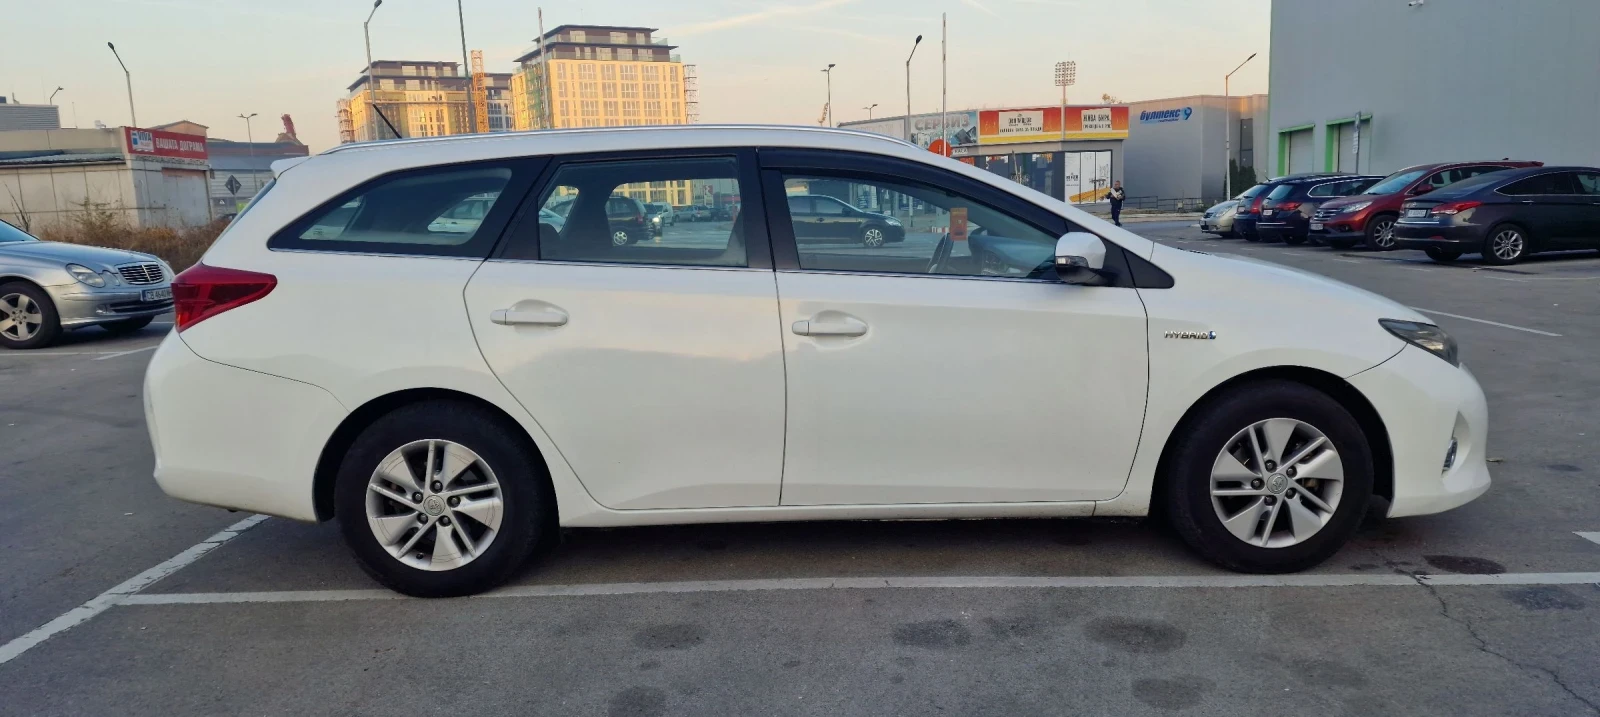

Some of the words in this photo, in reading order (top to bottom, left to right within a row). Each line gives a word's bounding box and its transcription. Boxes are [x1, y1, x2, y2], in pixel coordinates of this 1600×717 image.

[1140, 109, 1181, 121] бултекс
[914, 113, 969, 130] СЕРВИЗ
[137, 131, 152, 141] VIVA
[155, 138, 178, 150] ВАШАТА
[179, 140, 205, 153] ДОГРАМА
[1164, 330, 1209, 340] HYBRID
